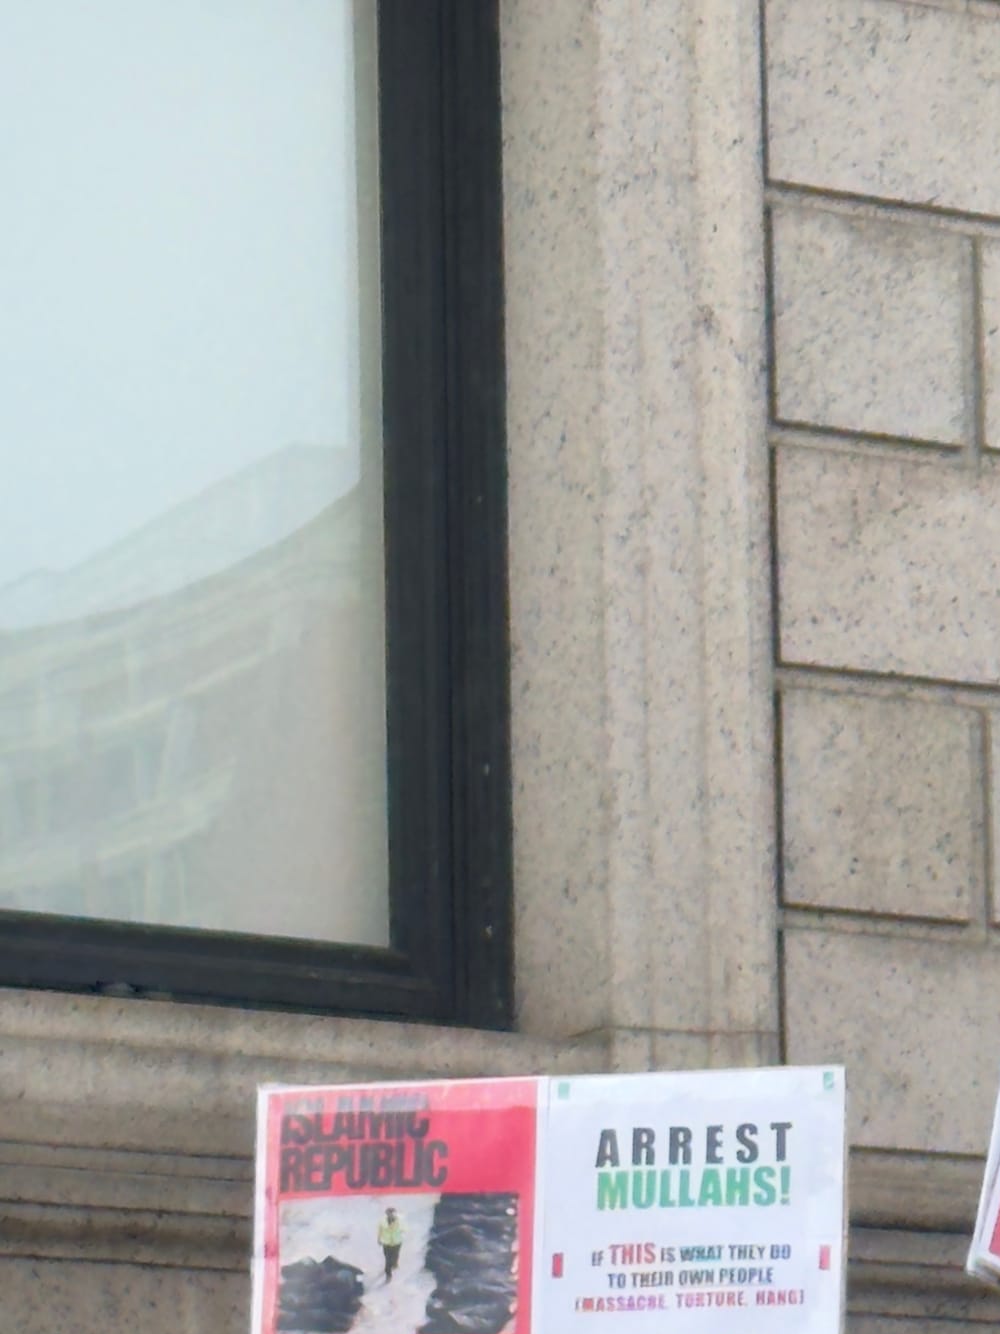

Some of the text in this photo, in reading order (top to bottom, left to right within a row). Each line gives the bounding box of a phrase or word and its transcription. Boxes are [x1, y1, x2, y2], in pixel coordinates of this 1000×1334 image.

[281, 1093, 430, 1146] ISLAMIC
[279, 1139, 448, 1193] REPUBLIC
[595, 1122, 792, 1168] ARREST
[597, 1166, 791, 1210] MULLAHS!
[608, 1242, 656, 1266] THIS
[660, 1247, 676, 1263] IS
[679, 1245, 724, 1262] WHAT
[728, 1244, 766, 1261] THEY
[770, 1244, 791, 1260] DO
[607, 1267, 774, 1289] TO THEIR OWN PEOPLE
